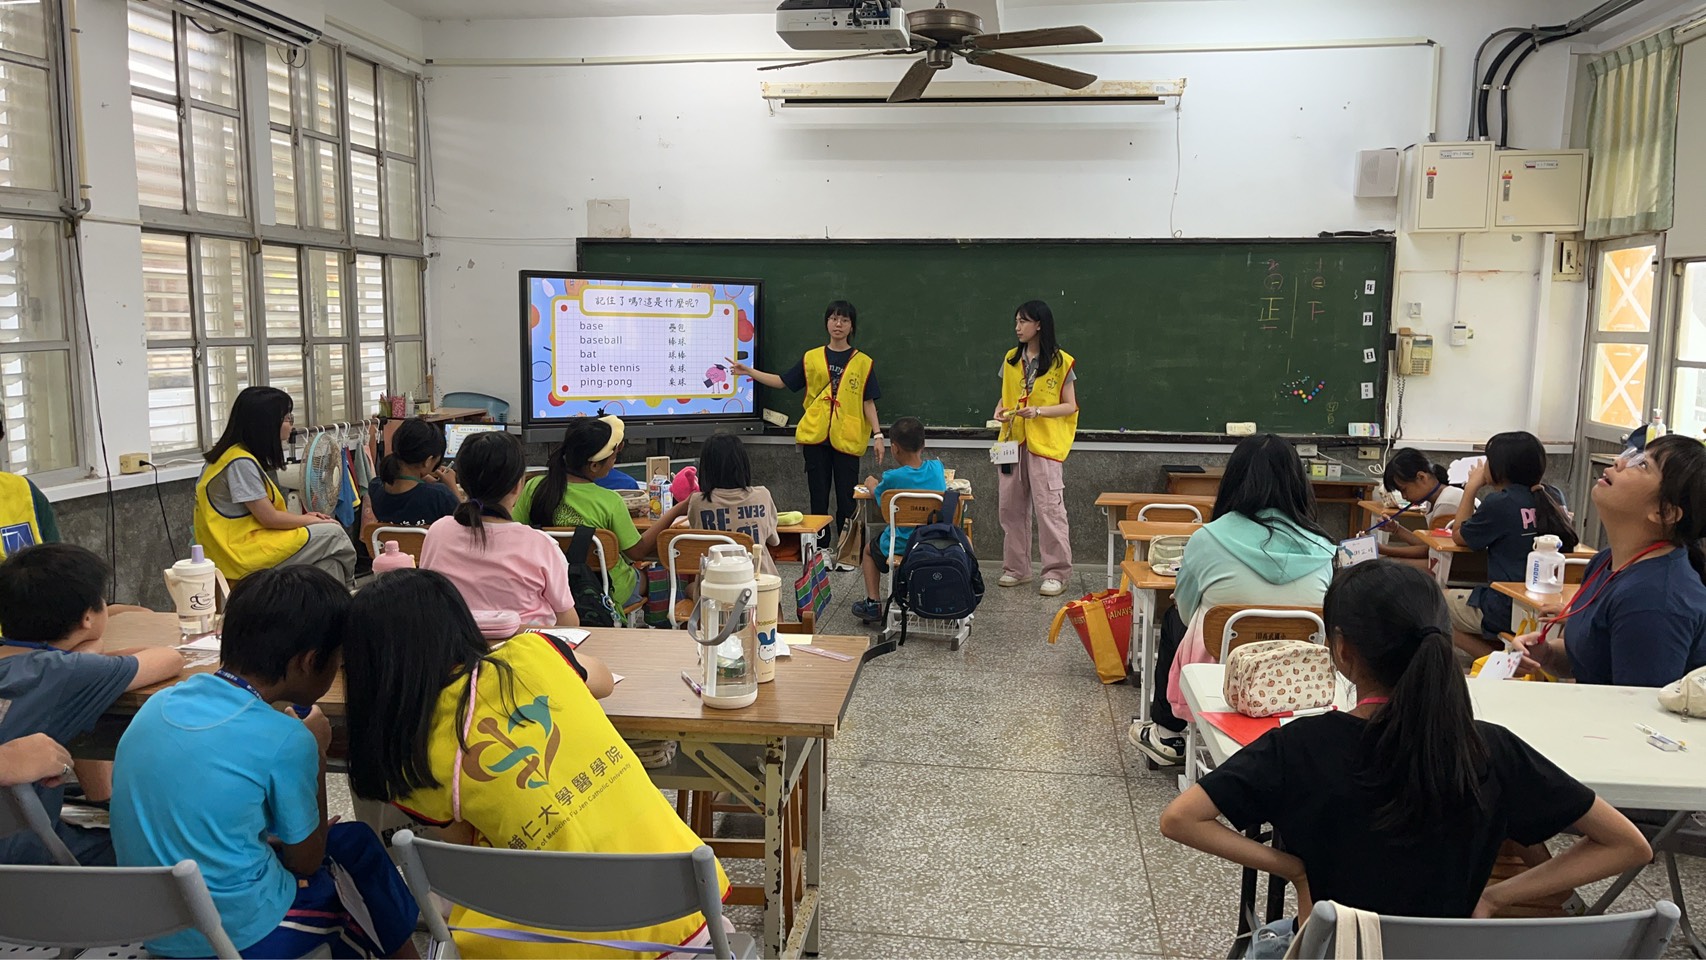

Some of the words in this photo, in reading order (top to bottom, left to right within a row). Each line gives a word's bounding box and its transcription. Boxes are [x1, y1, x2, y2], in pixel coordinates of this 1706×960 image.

[579, 321, 604, 330] base
[579, 335, 623, 345] baseball
[668, 337, 686, 346] 棒球
[579, 349, 597, 359] bat
[668, 350, 687, 360] 球棒
[579, 363, 606, 373] table
[609, 363, 641, 373] tennis
[580, 377, 633, 389] ping-pong
[507, 745, 624, 850] 輔仁大學醫學院
[546, 816, 571, 840] Medicine
[570, 809, 579, 818] Fu
[579, 801, 588, 811] Jen
[587, 782, 609, 802] Catholic
[609, 763, 631, 784] University
